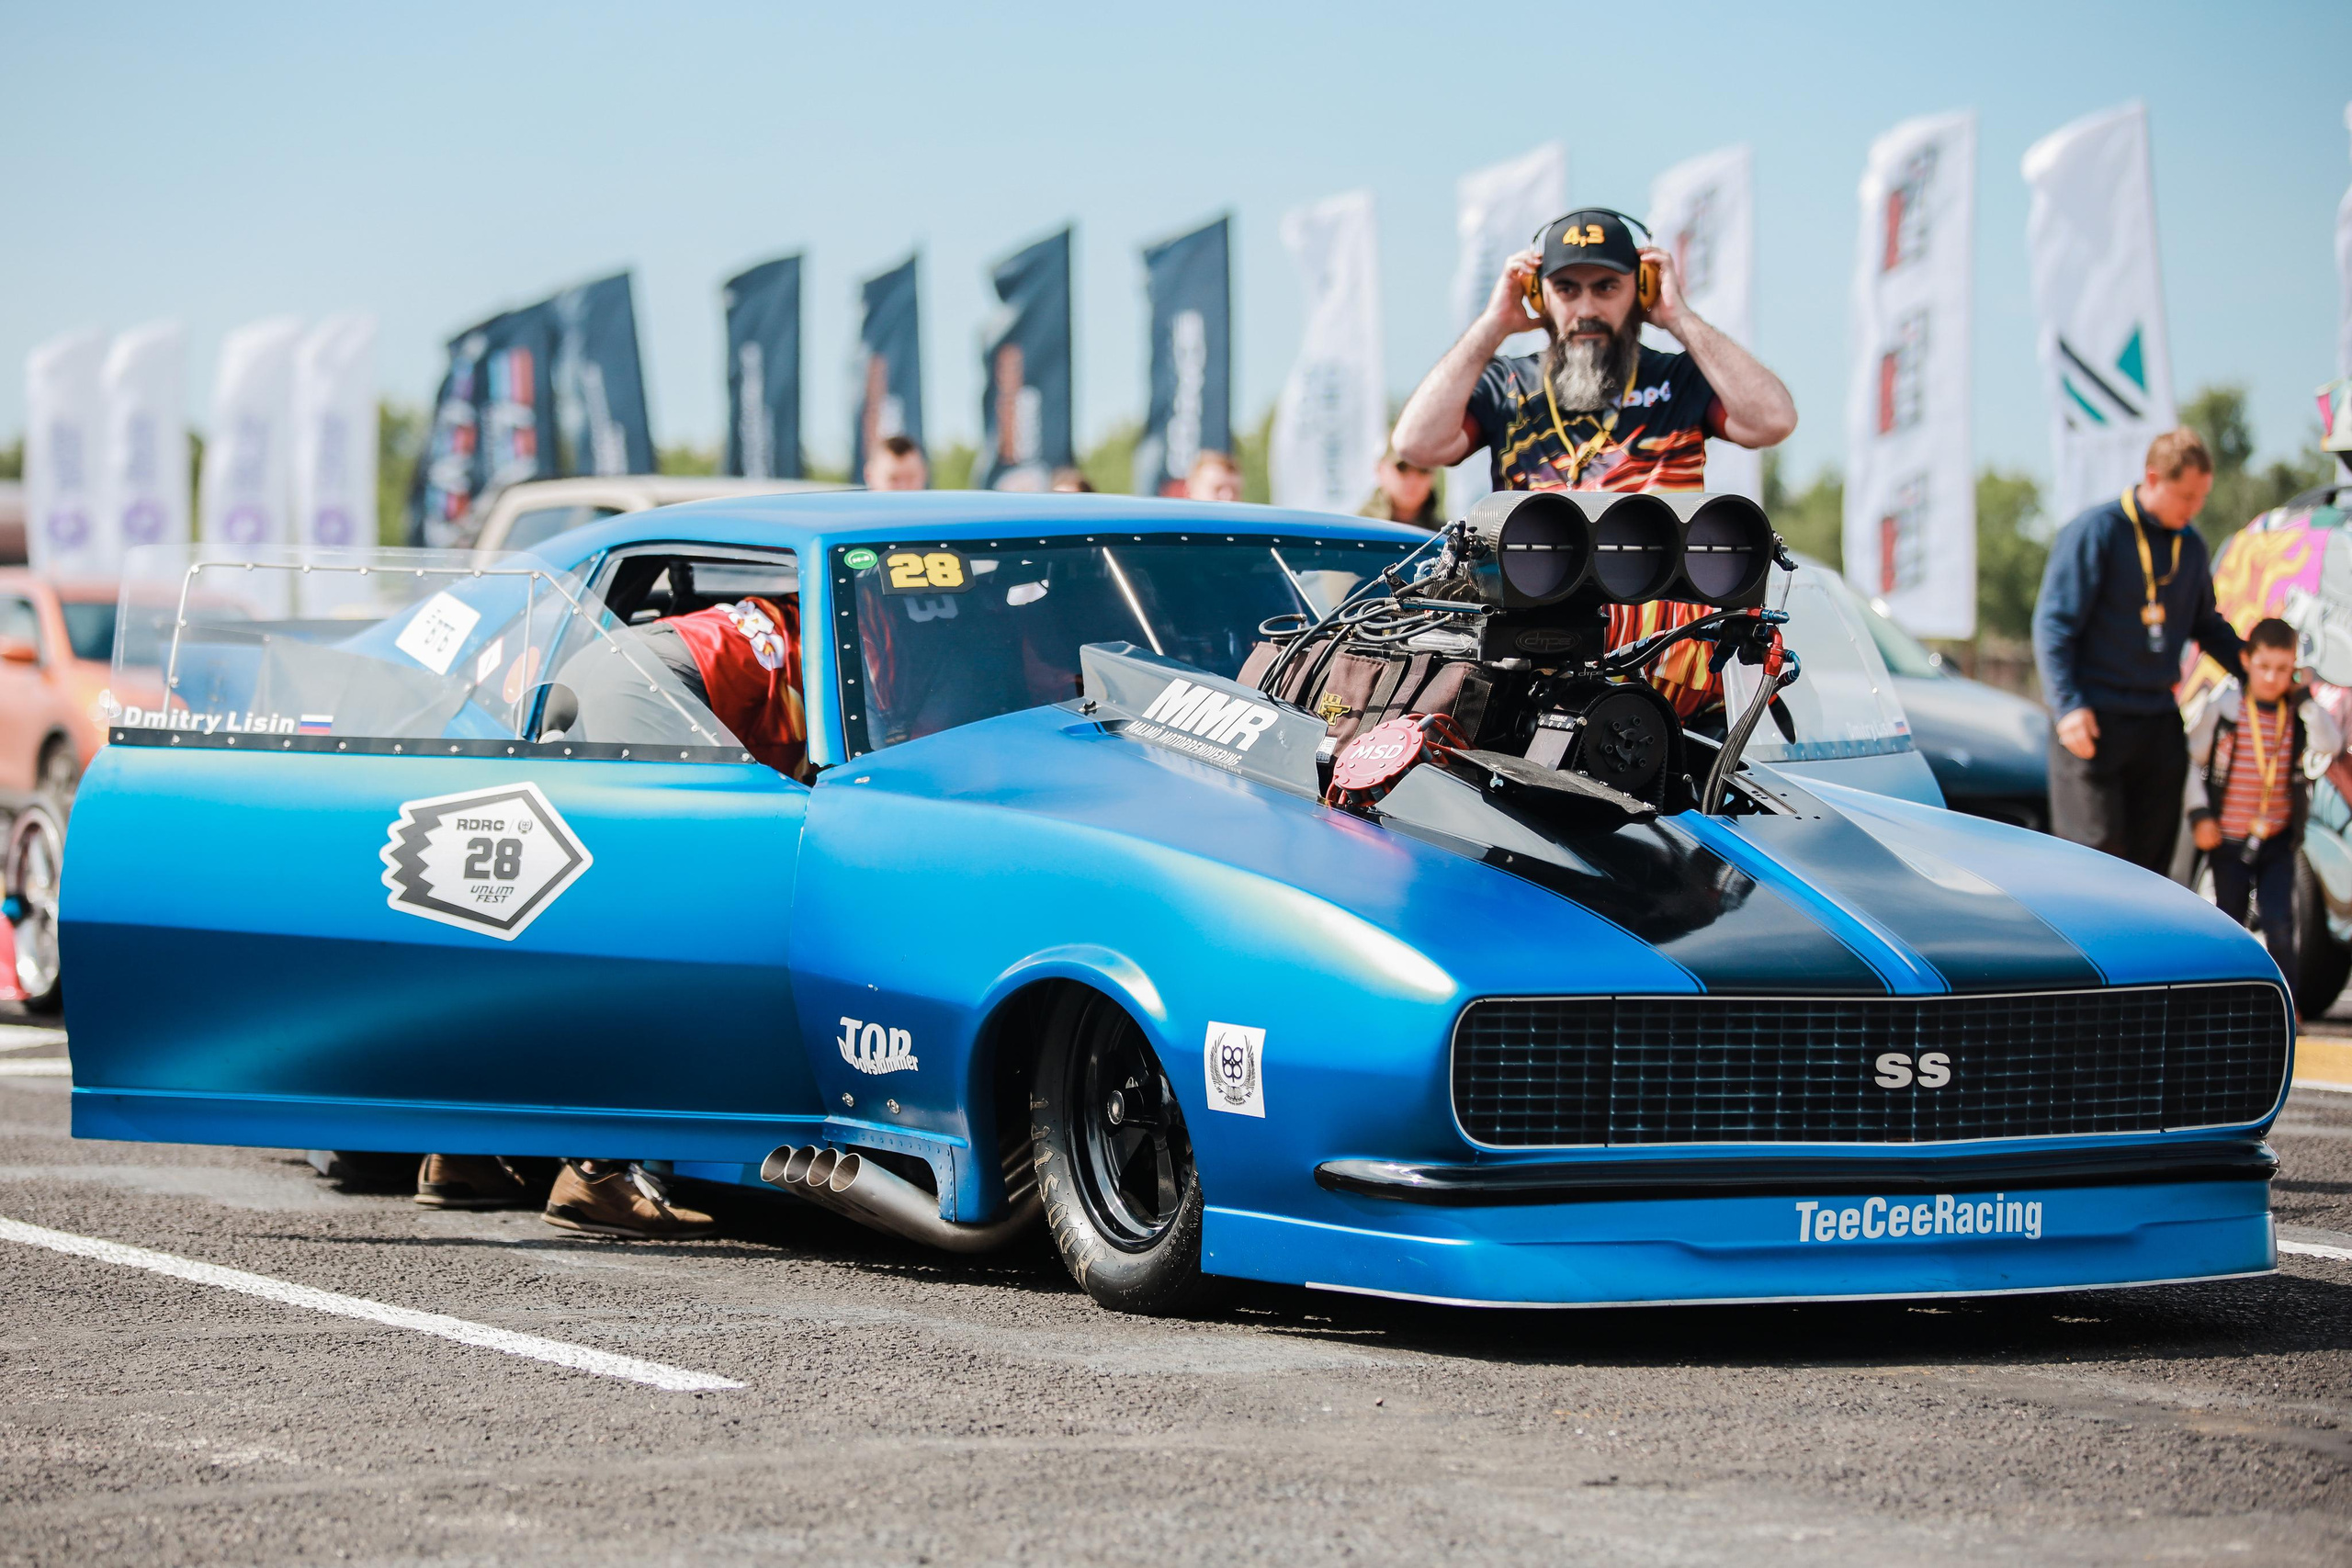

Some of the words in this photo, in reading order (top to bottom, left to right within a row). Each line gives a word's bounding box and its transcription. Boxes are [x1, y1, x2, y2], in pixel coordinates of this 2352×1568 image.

[1563, 224, 1605, 248] 4,3
[887, 553, 964, 588] 28
[124, 705, 222, 735] Dmitry
[226, 711, 295, 734] Lisin
[1141, 678, 1279, 751] MMR
[1124, 720, 1167, 741] MALMÖ
[1159, 731, 1243, 766] MOTORRENOVERING
[1350, 744, 1404, 760] MSD
[457, 818, 505, 831] RDRC
[464, 837, 523, 880] 28
[475, 895, 509, 904] FEST
[840, 1016, 912, 1063] TOP
[1874, 1053, 1951, 1089] SS
[1795, 1192, 2042, 1240] TeeCeeRacing
